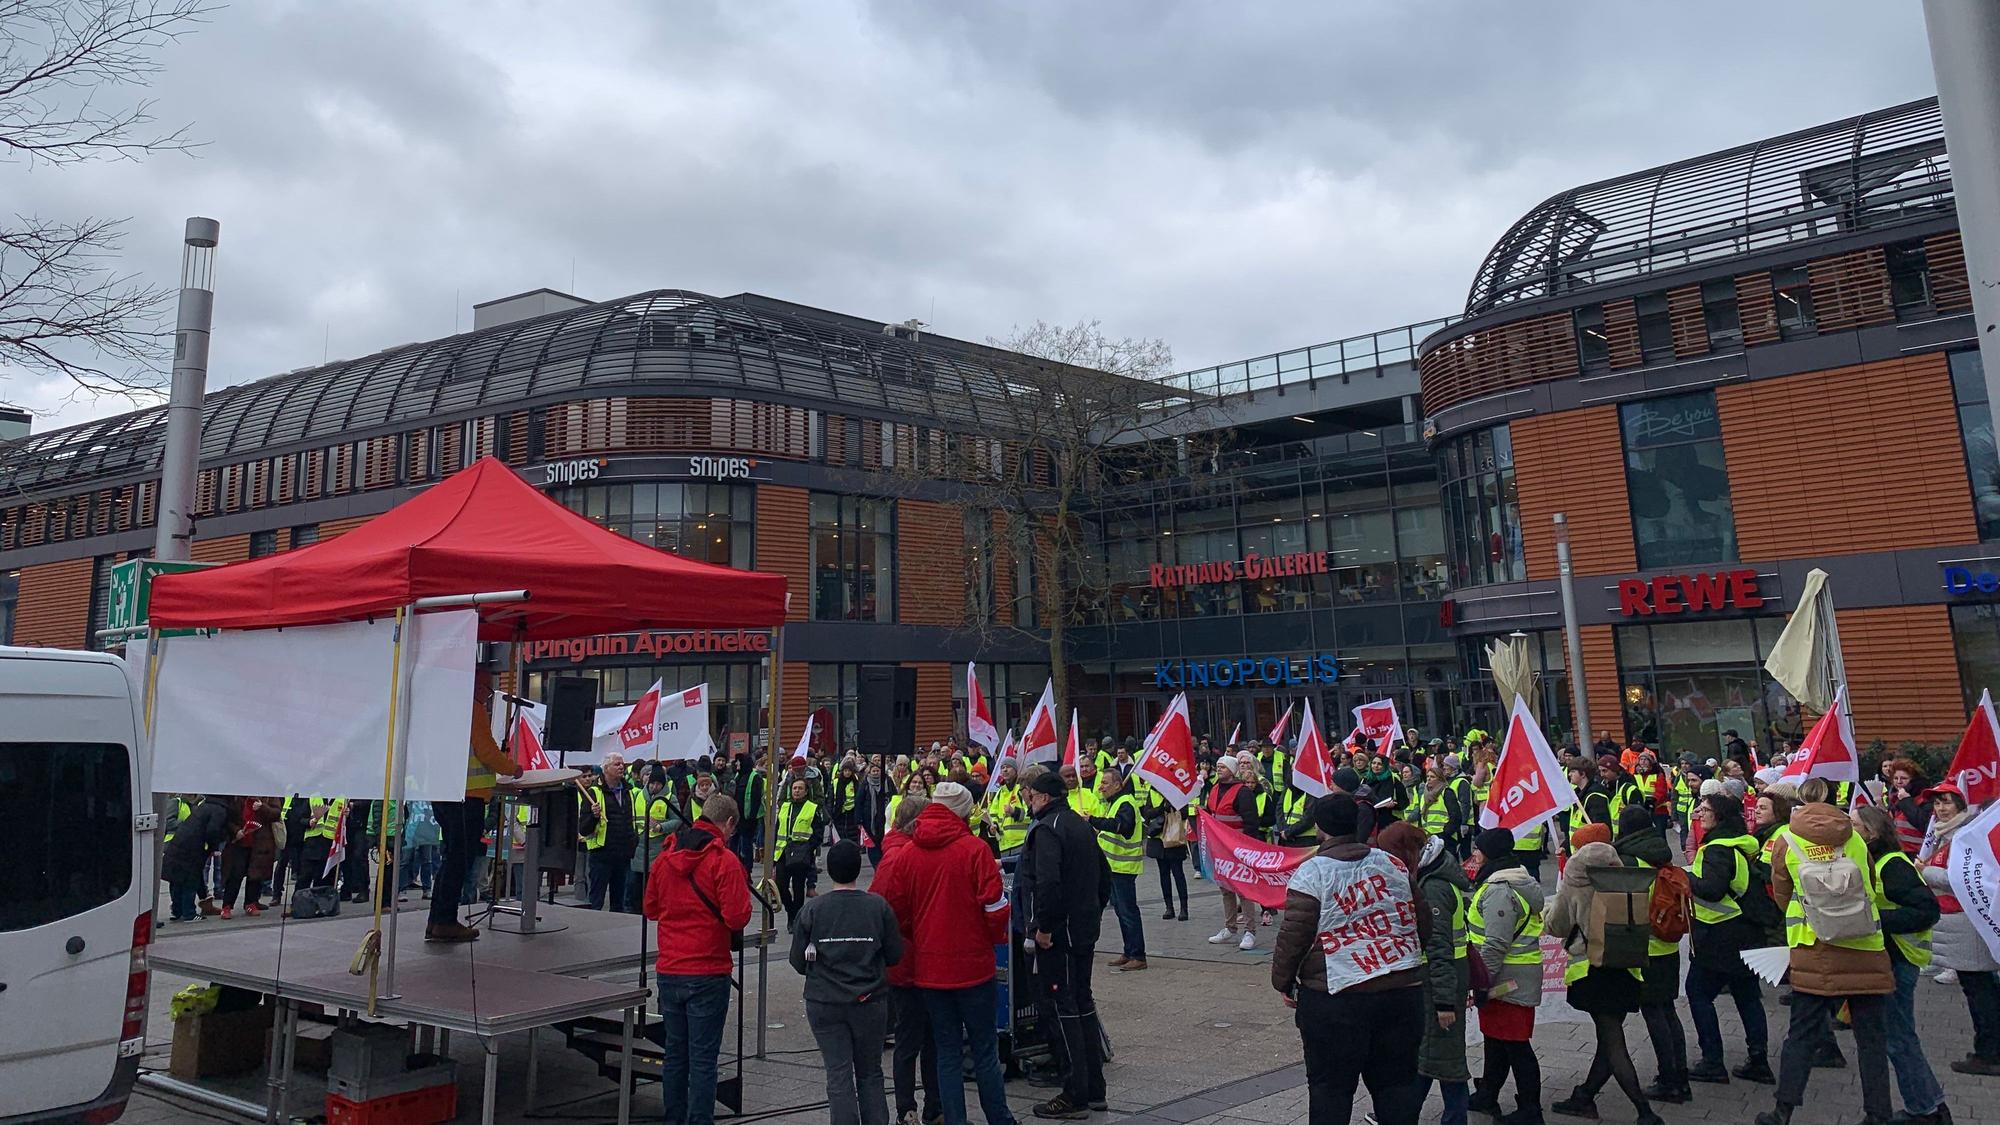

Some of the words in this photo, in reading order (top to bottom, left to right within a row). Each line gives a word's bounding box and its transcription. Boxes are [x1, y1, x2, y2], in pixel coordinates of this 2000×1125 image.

[1150, 551, 1329, 588] RATHAUS-GALERIE
[1617, 569, 1764, 617] REWE
[533, 635, 629, 663] Pinguin
[632, 628, 769, 658] Apotheke
[1154, 655, 1340, 688] KINOPOLIS
[1333, 875, 1392, 916] WIR
[1962, 847, 1978, 905] Sparkasse
